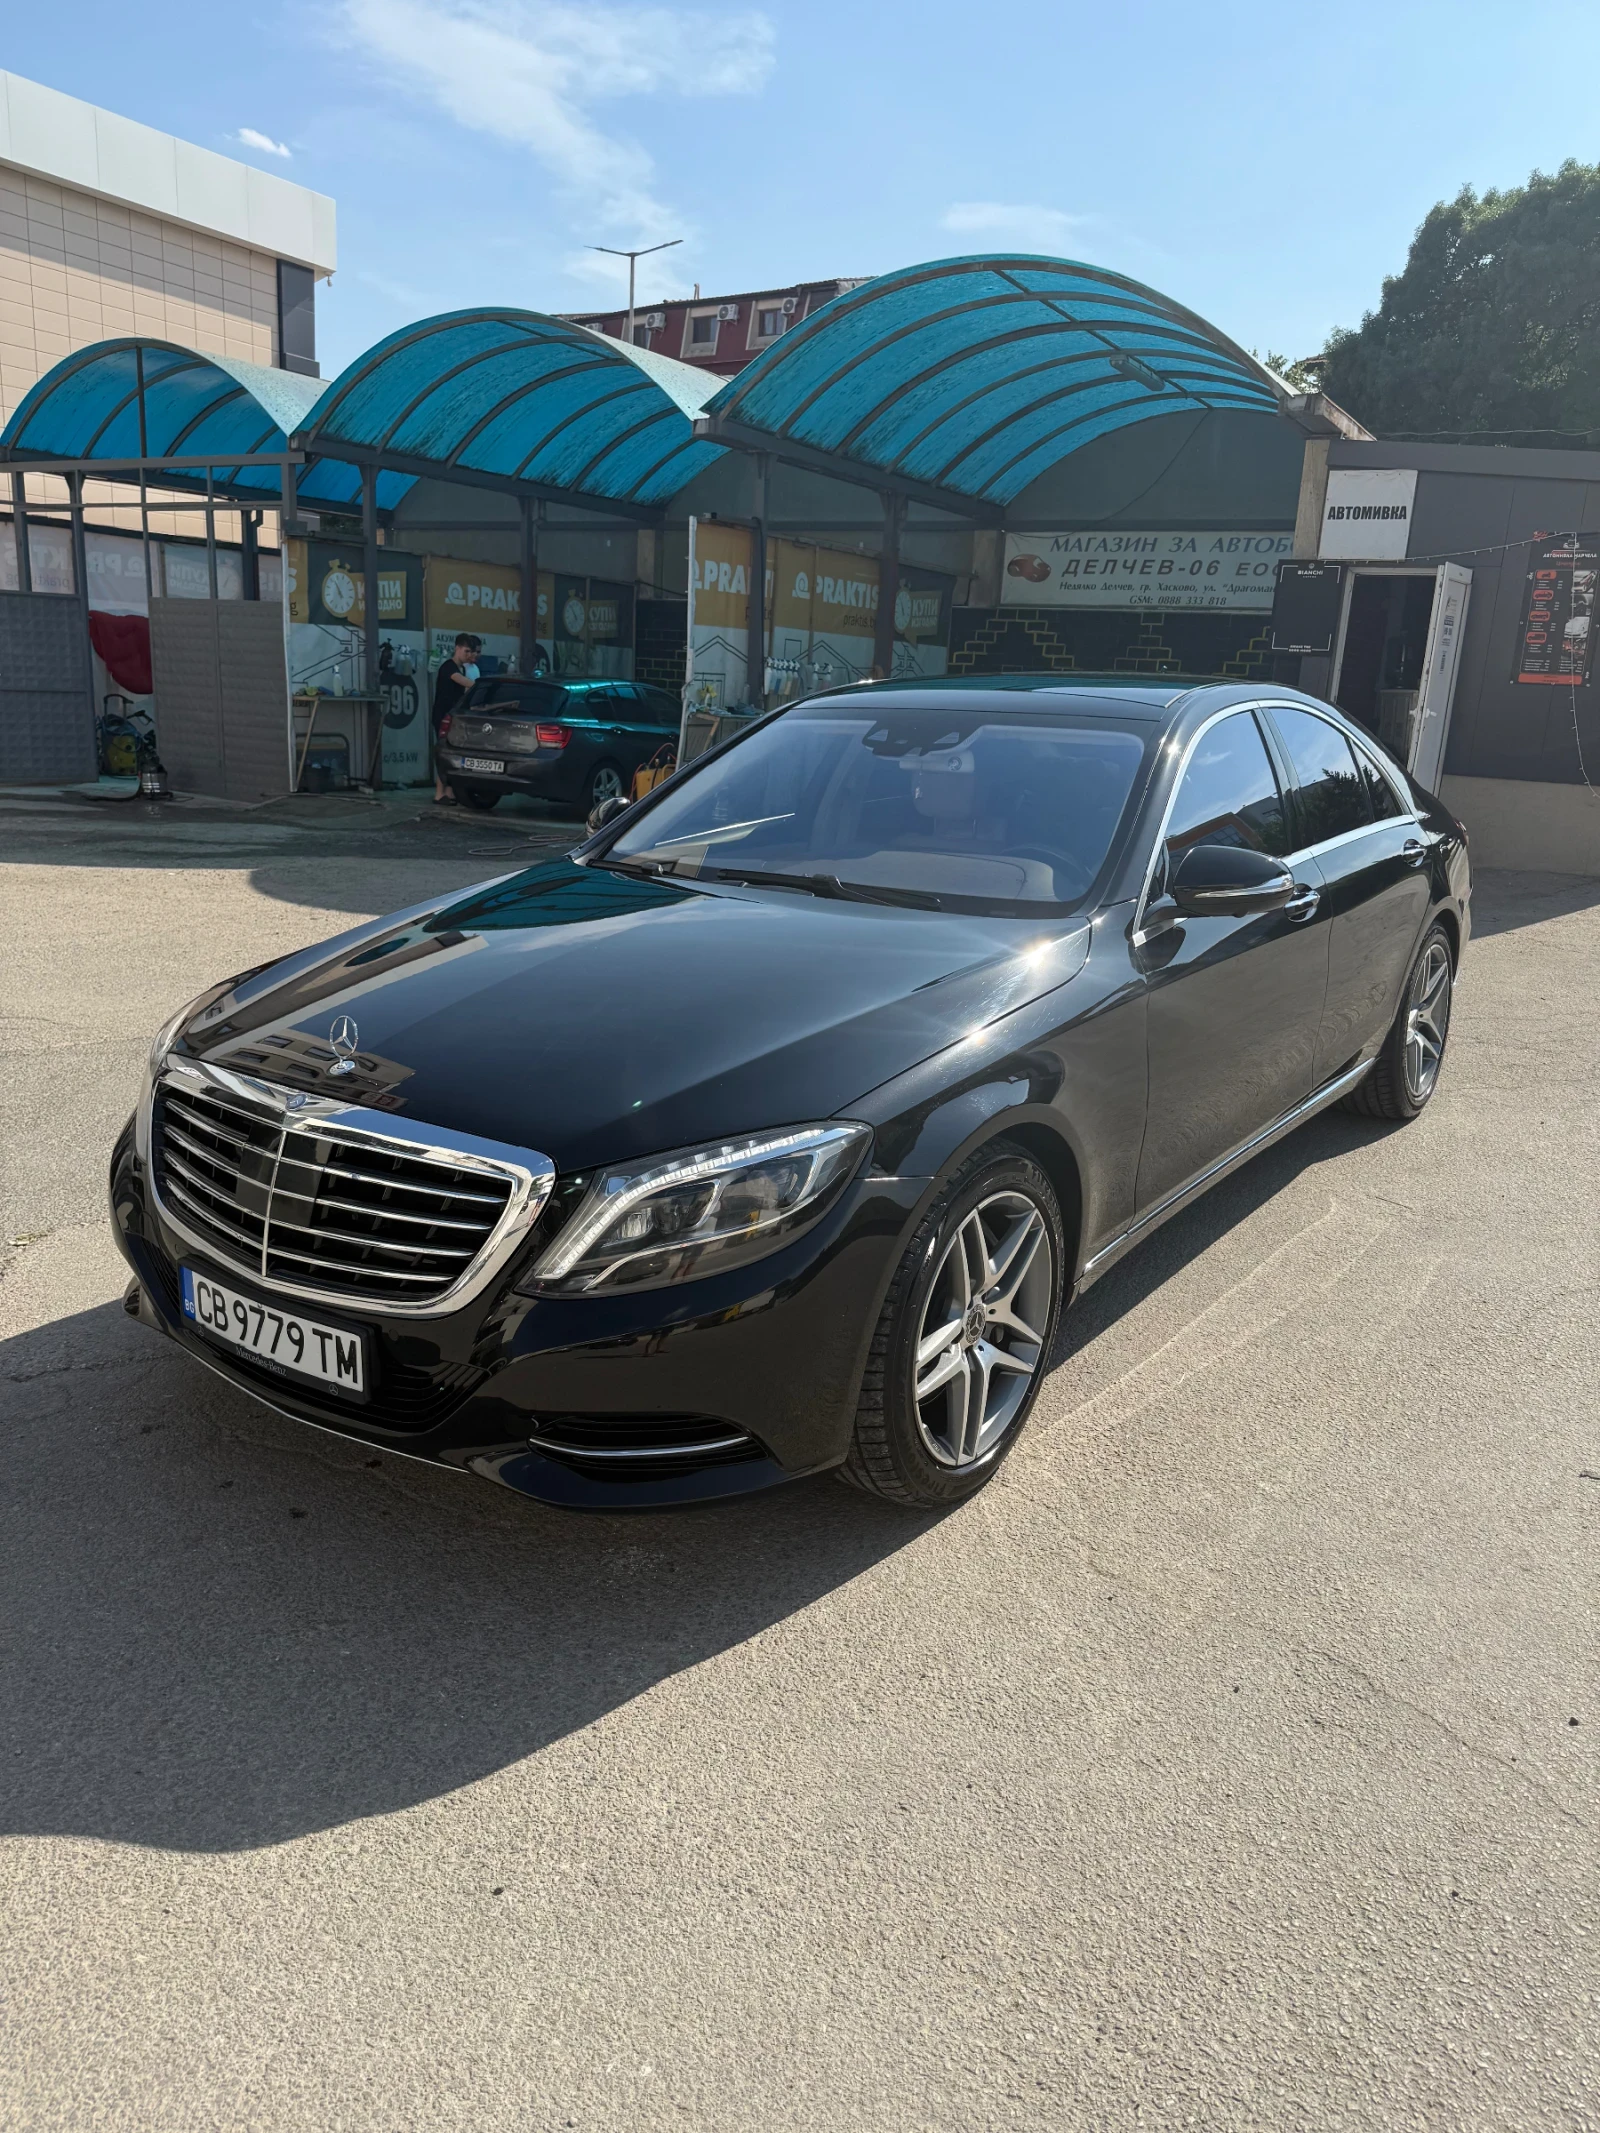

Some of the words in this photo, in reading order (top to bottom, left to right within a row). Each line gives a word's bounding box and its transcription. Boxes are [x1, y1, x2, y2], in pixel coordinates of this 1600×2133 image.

[1327, 505, 1407, 520] АВТОМИВКА
[1050, 537, 1159, 552] МАГАЗИН
[1168, 537, 1197, 552] ЗА
[1209, 537, 1294, 553] АВТОБ
[1061, 559, 1220, 577] ДЕЛЧЕВ-06
[1156, 583, 1198, 593] Хасково,
[912, 598, 939, 616] КУПИ
[1129, 595, 1153, 604] GSM:
[1157, 595, 1181, 604] 0888
[1185, 596, 1204, 605] 333
[1208, 597, 1227, 605] 818
[406, 752, 418, 763] kW
[465, 759, 474, 768] CB
[475, 760, 492, 769] 3550
[493, 762, 502, 771] TA
[184, 1298, 195, 1314] BG
[197, 1281, 228, 1332] CB
[233, 1299, 305, 1363] 9779
[312, 1328, 358, 1383] TM
[235, 1346, 287, 1377] Mercedes-Benz
